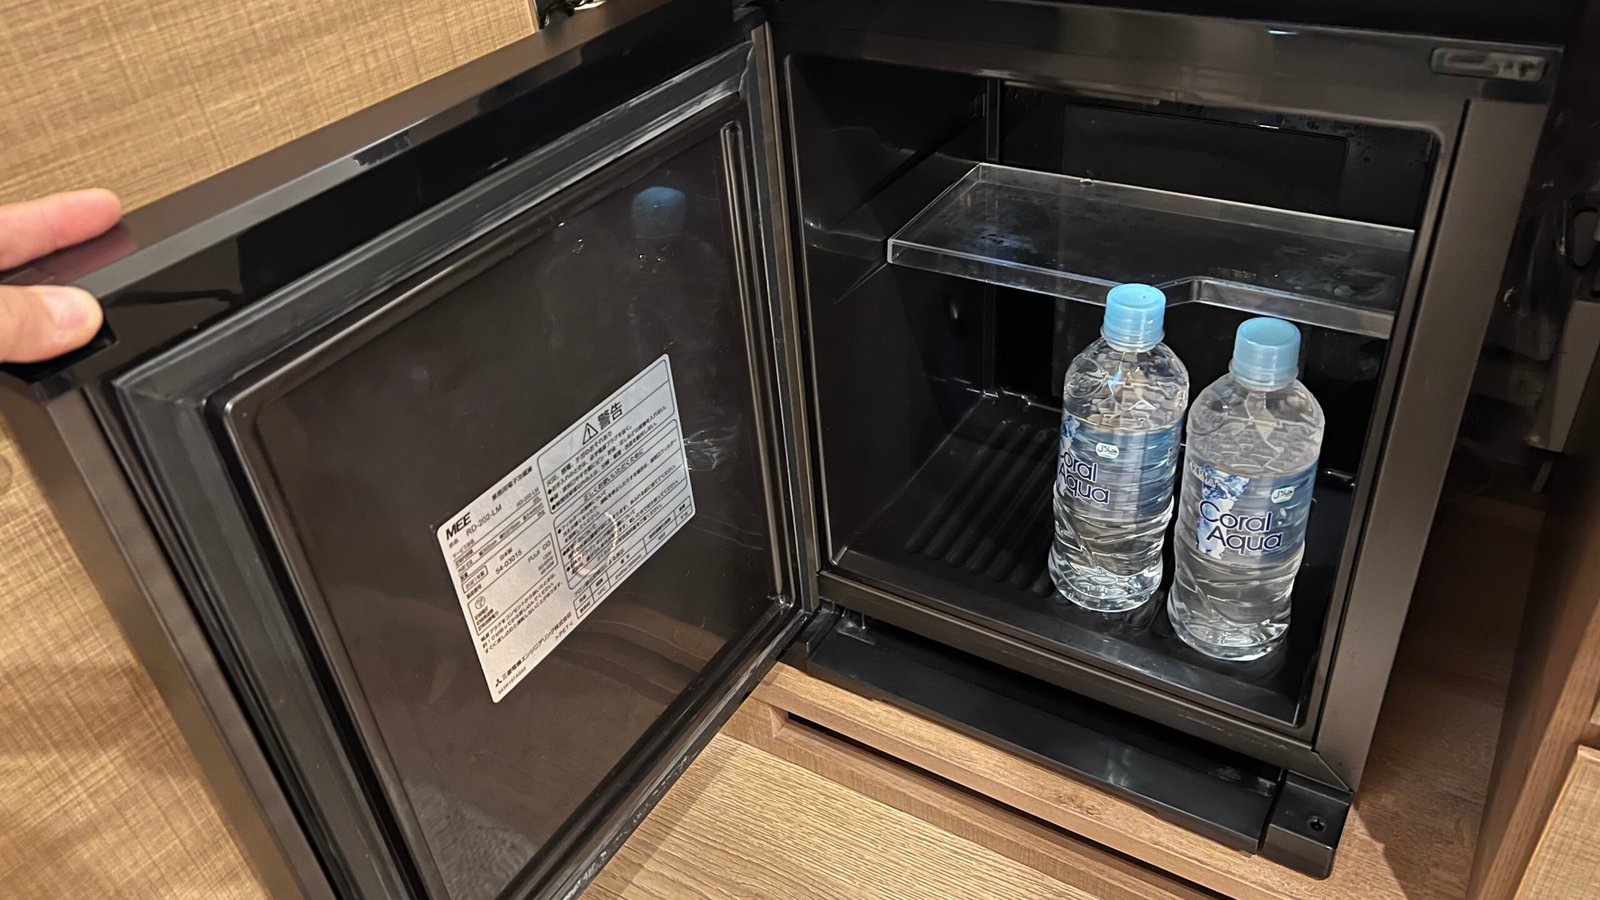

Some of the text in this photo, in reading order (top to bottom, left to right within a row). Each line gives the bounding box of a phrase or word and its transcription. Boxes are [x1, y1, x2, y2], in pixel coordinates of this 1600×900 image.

[598, 401, 623, 430] 警告
[1060, 451, 1098, 482] oral
[445, 512, 471, 541] MEE
[465, 503, 502, 537] RD-202-LM
[1200, 501, 1272, 532] Coral
[1206, 525, 1283, 555] Aqua
